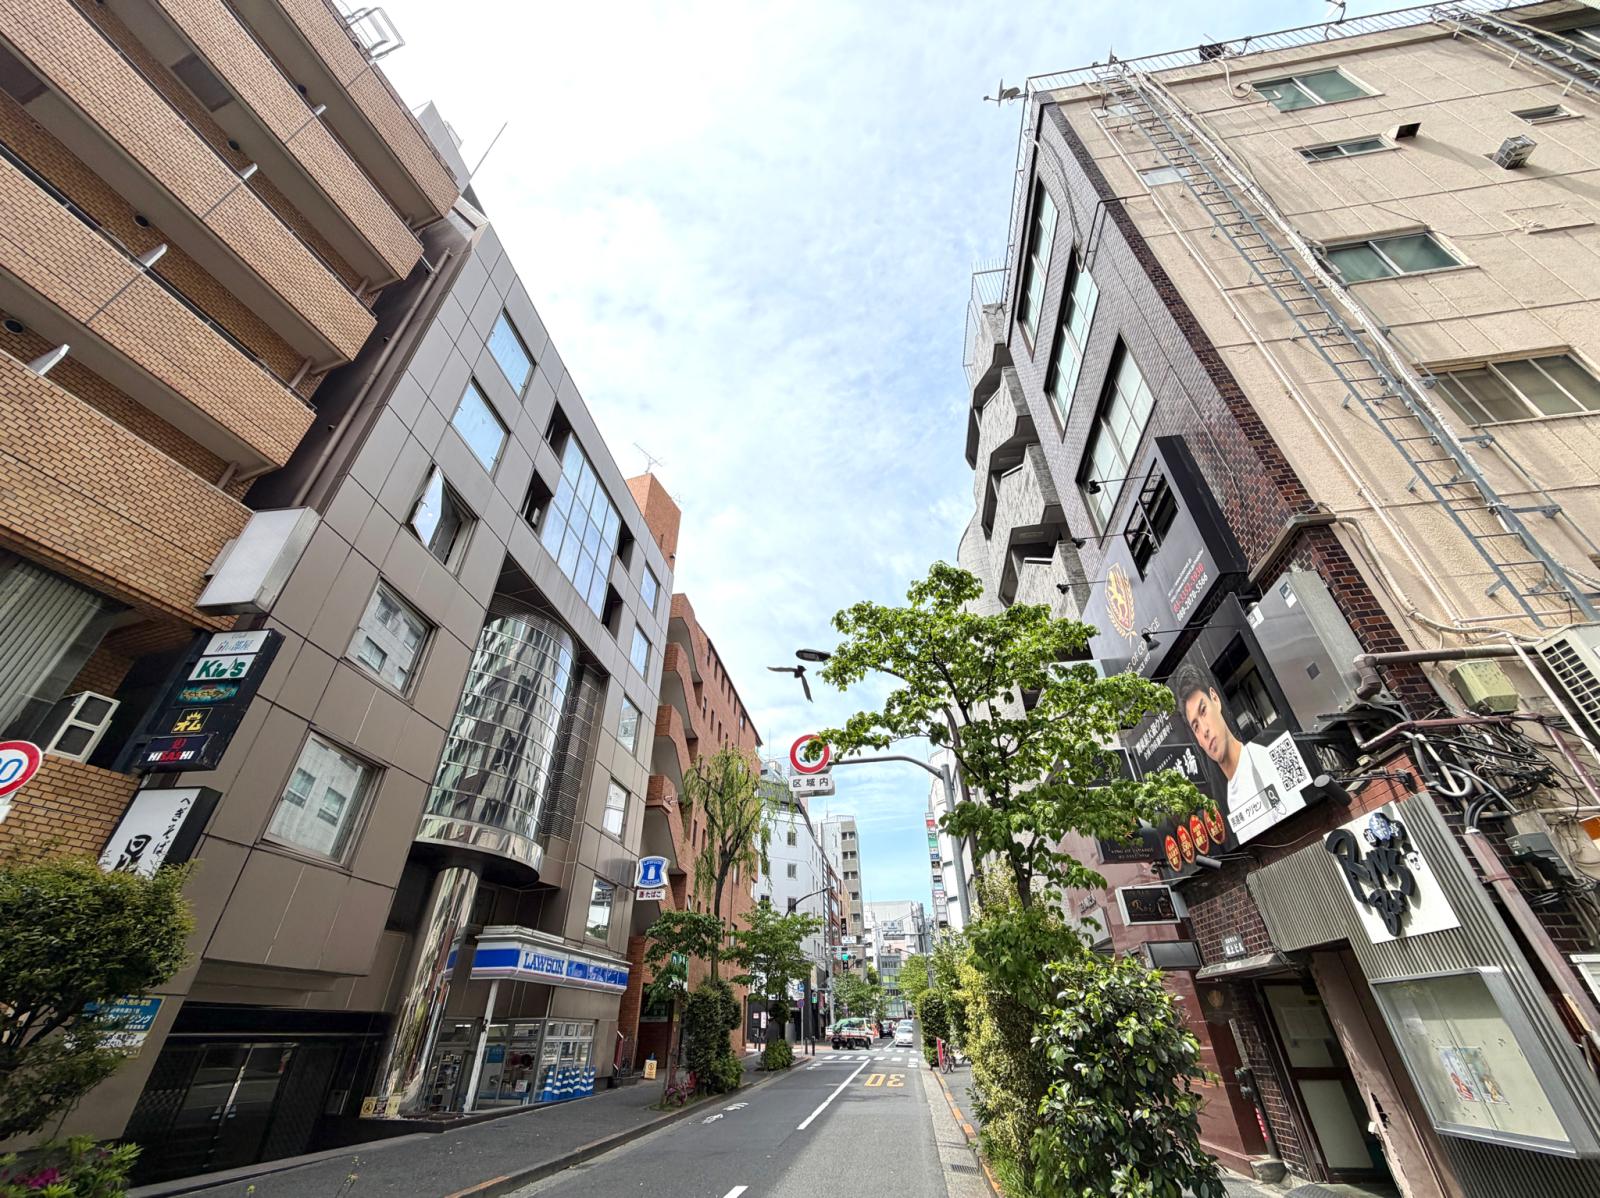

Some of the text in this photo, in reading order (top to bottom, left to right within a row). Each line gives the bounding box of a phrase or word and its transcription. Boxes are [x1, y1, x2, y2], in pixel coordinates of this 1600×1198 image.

[792, 777, 829, 788] 区域内
[1245, 801, 1262, 817] ウリセン
[523, 952, 565, 975] LAWSON
